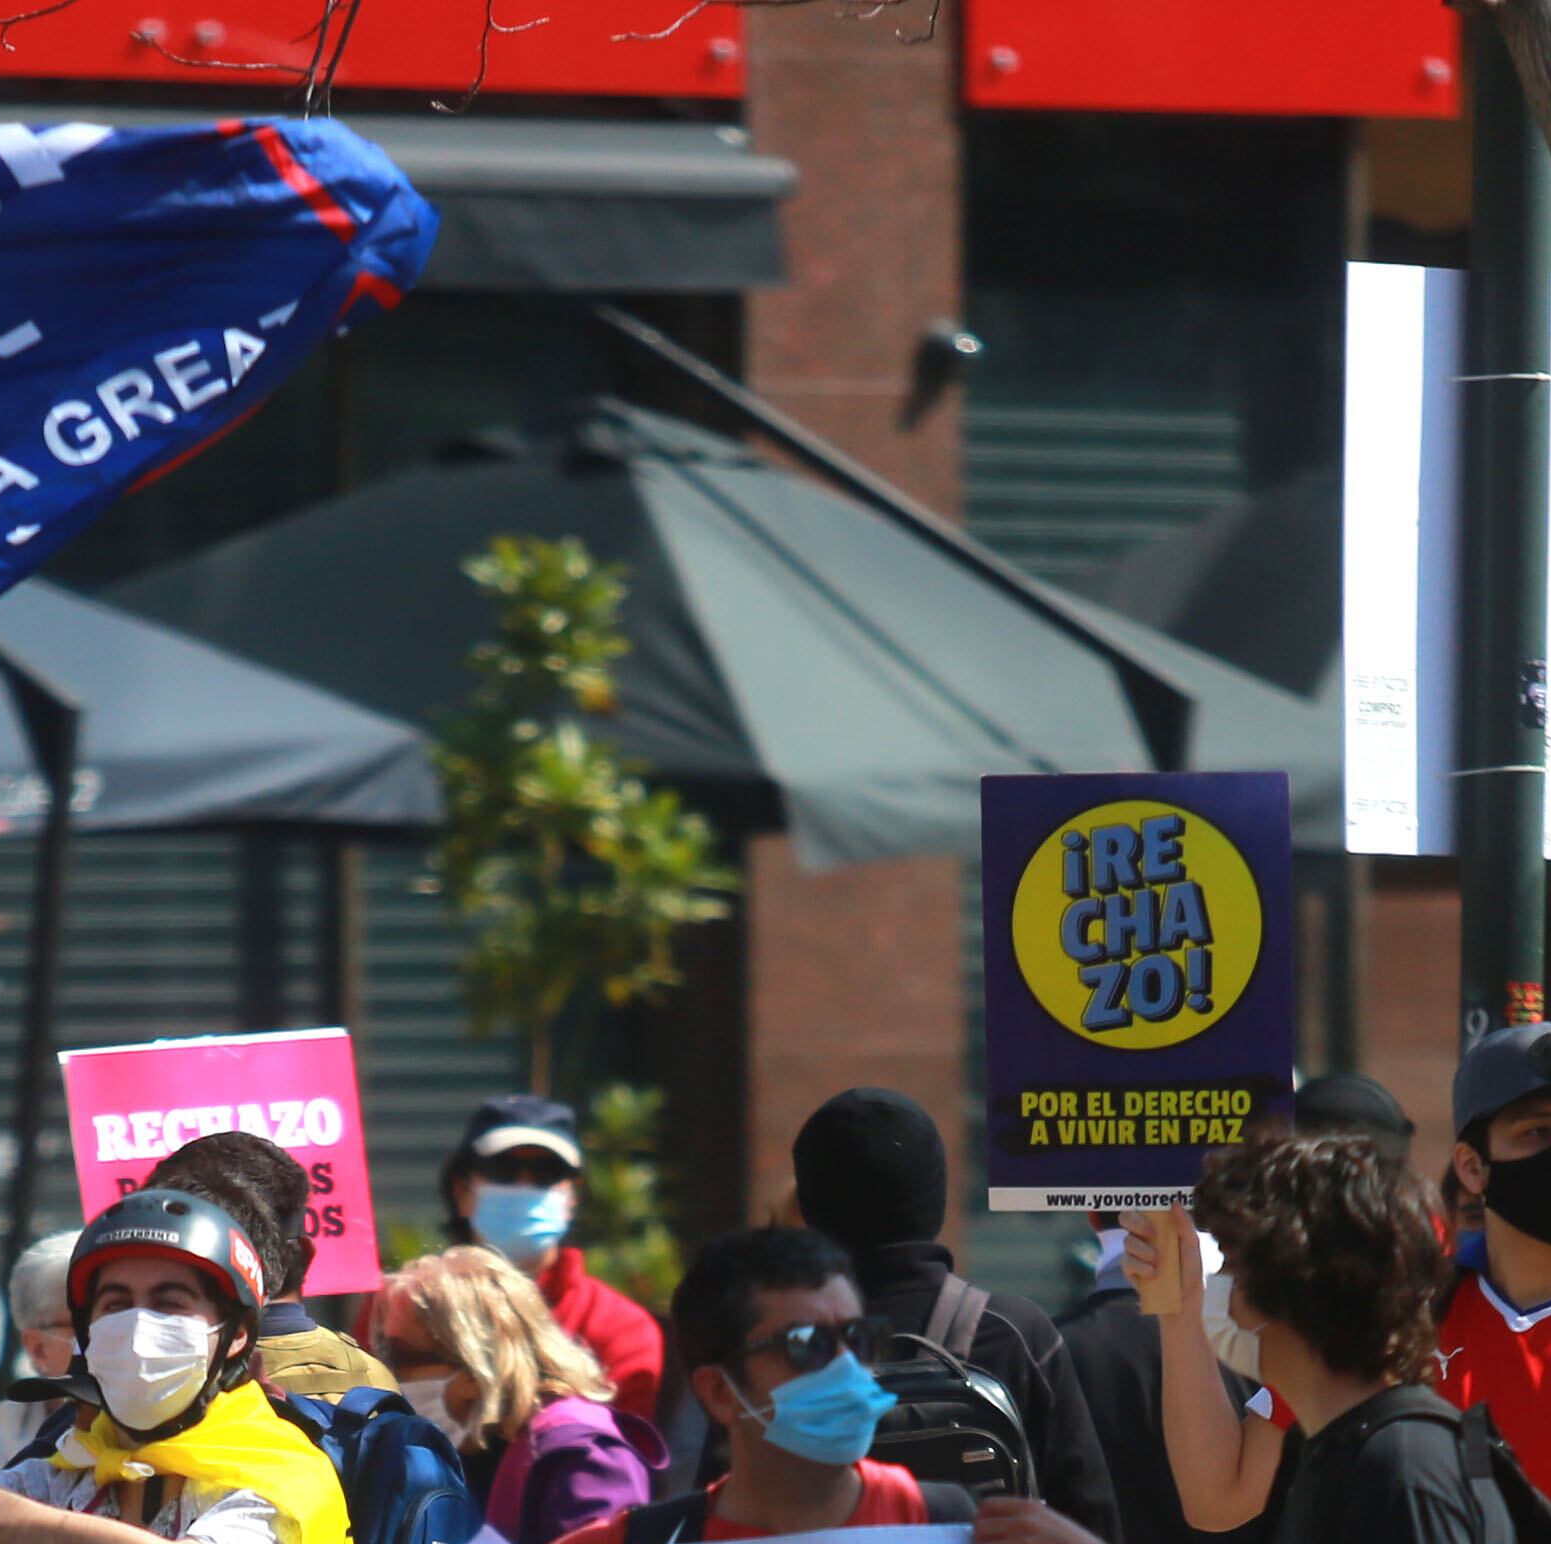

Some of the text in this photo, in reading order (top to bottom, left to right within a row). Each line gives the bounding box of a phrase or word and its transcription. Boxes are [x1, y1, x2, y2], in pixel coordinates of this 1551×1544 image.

[1061, 814, 1187, 898] ¡RE
[1060, 879, 1214, 965] CHA
[1078, 946, 1214, 1033] ZO!
[1021, 1089, 1251, 1117] POR EL DERECHO
[1030, 1118, 1244, 1145] A VIVIR EN PAZ
